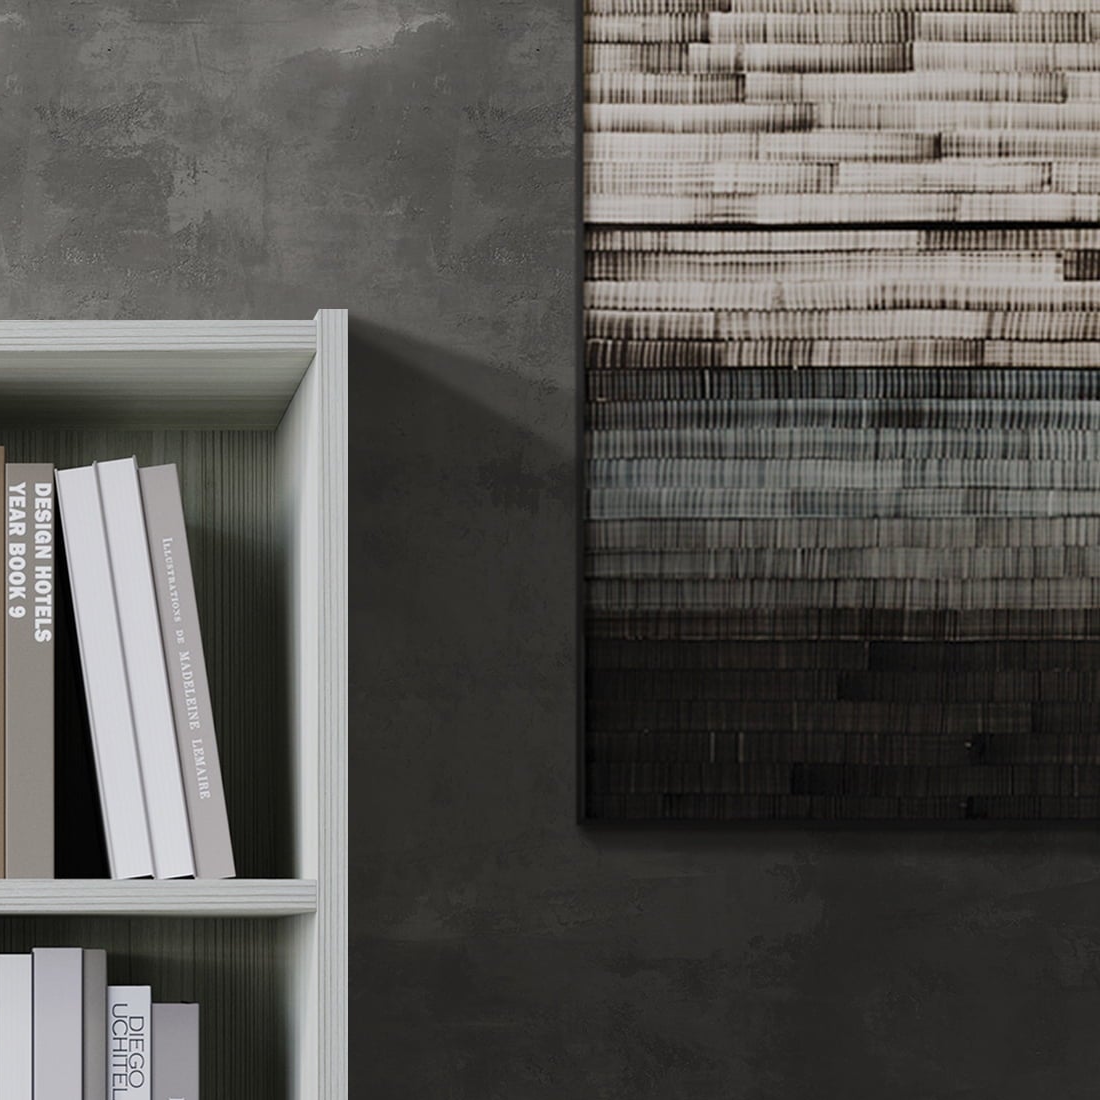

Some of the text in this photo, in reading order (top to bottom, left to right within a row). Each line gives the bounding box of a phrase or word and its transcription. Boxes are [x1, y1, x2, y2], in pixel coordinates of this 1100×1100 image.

[9, 482, 26, 618] YEAR BOOK 9
[34, 482, 52, 642] DESIGN HOTELS
[179, 651, 200, 729] MADELEINE
[192, 740, 210, 799] LEMAIRE
[128, 1015, 145, 1089] DIEGO
